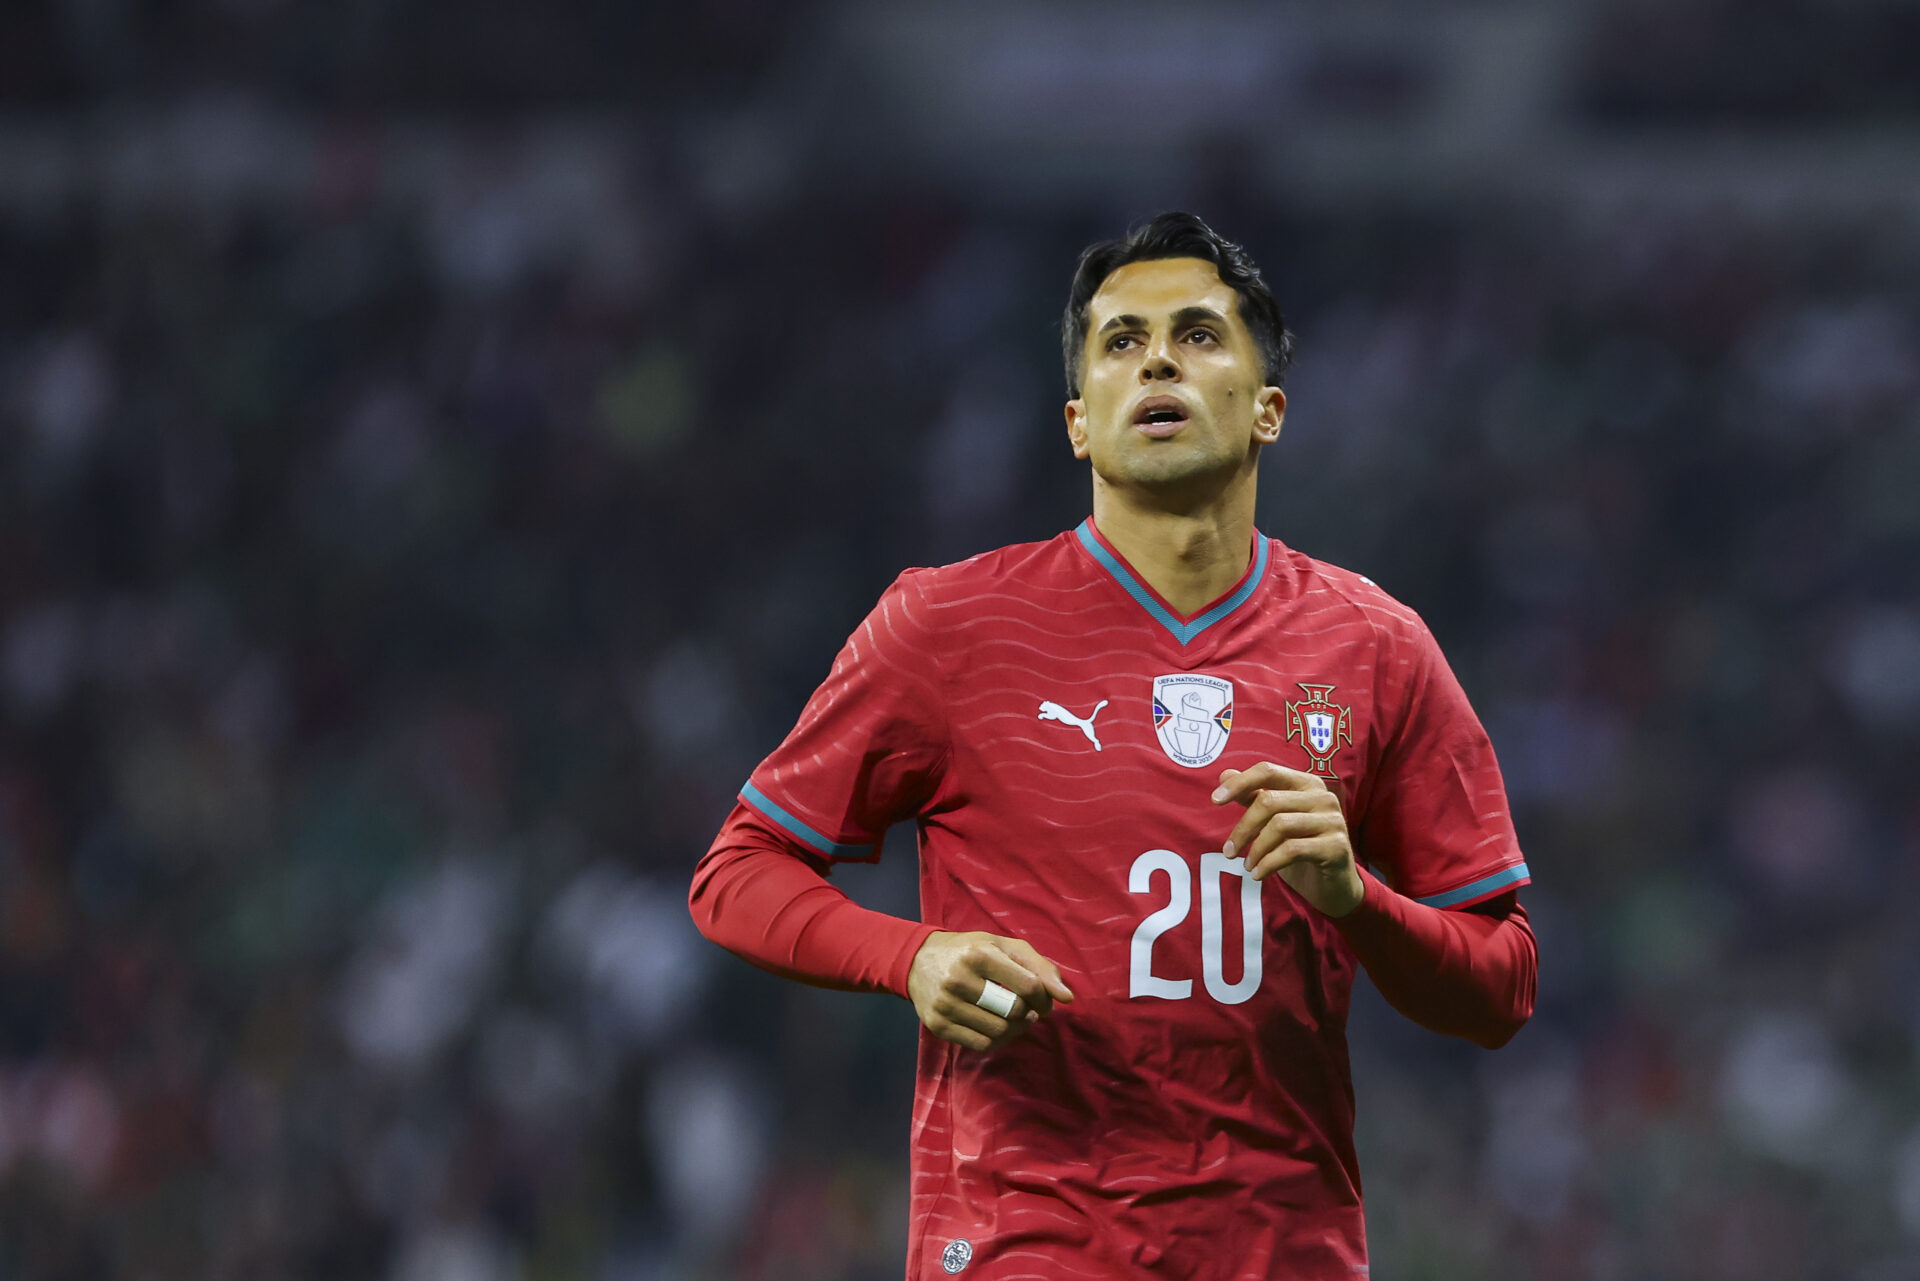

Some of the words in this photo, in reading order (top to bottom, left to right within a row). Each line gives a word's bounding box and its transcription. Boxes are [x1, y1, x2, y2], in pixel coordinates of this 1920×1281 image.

[1157, 677, 1174, 685] UEFA
[1205, 678, 1229, 690] LEAGUE
[1172, 752, 1198, 765] WINNER
[1199, 755, 1213, 764] 2025
[1128, 849, 1263, 1005] 20
